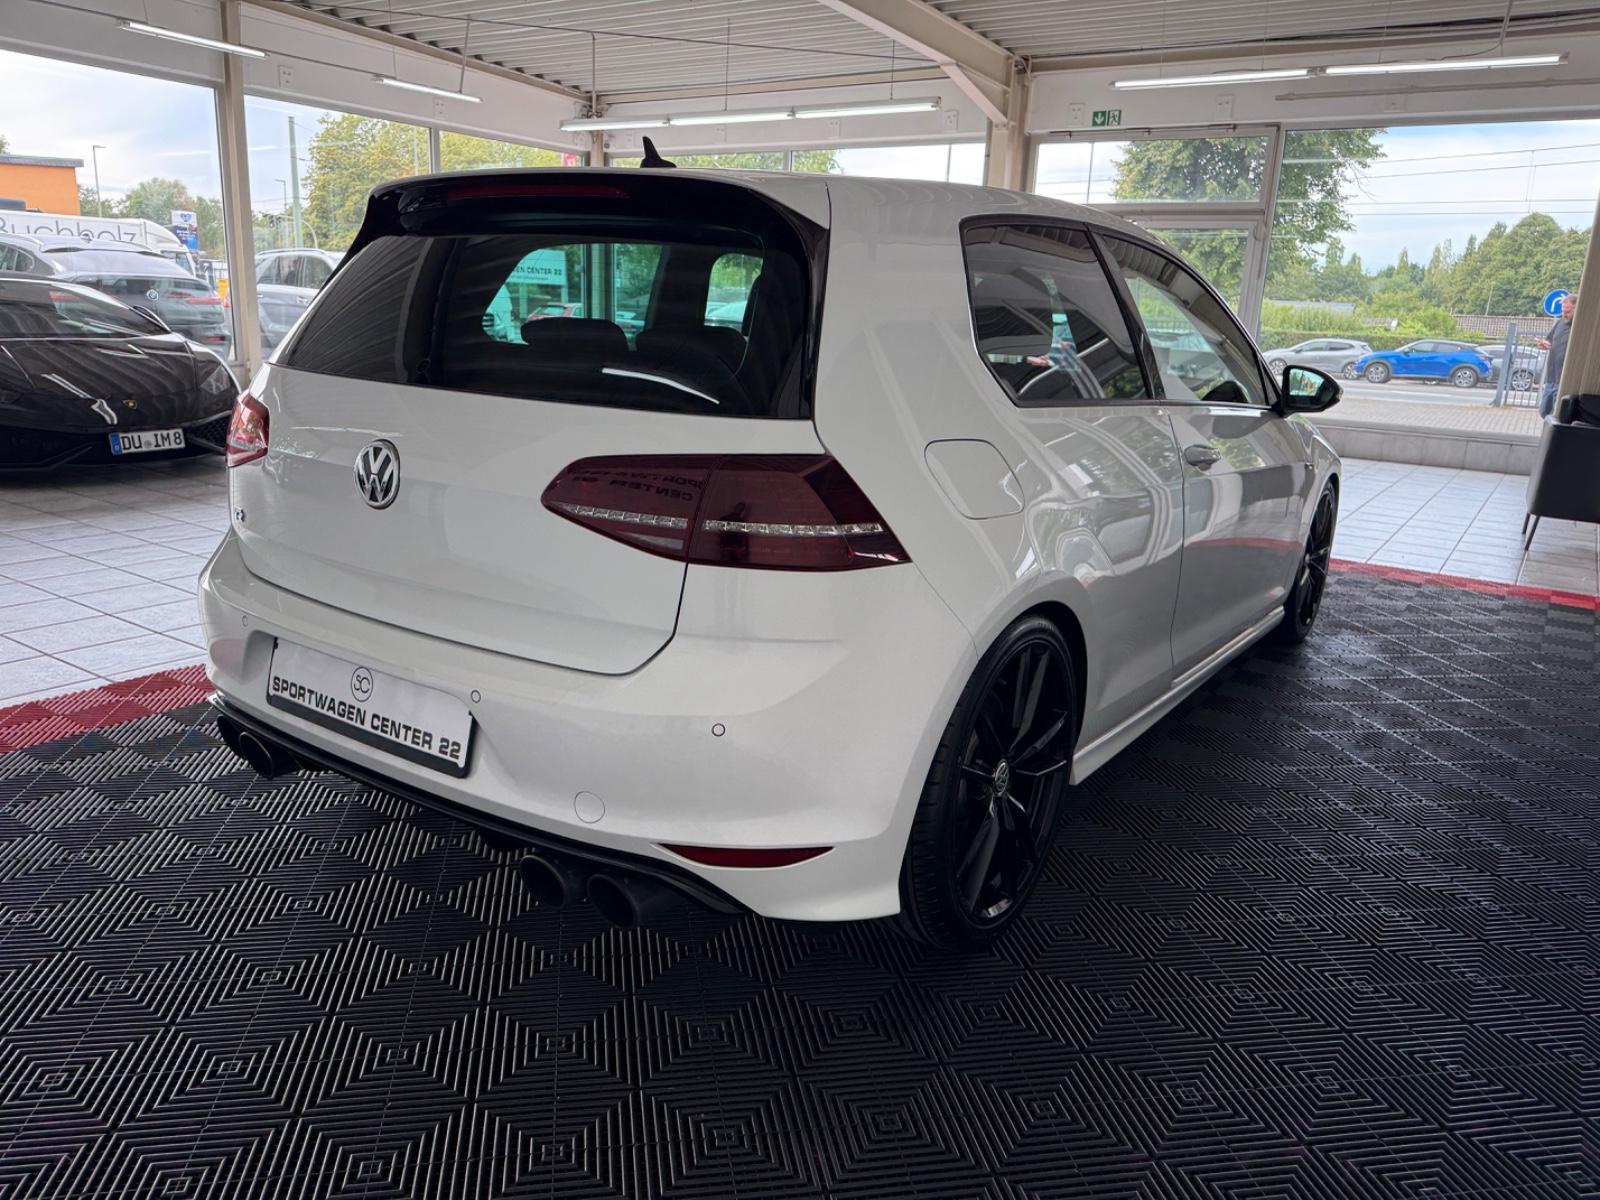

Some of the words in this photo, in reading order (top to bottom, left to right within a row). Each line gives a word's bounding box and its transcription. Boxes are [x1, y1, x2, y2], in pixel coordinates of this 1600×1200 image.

[527, 266, 553, 275] CENTER
[120, 434, 143, 450] DU
[272, 676, 367, 727] SPORTWAGEN
[370, 713, 433, 751] CENTER
[438, 737, 461, 760] 22
